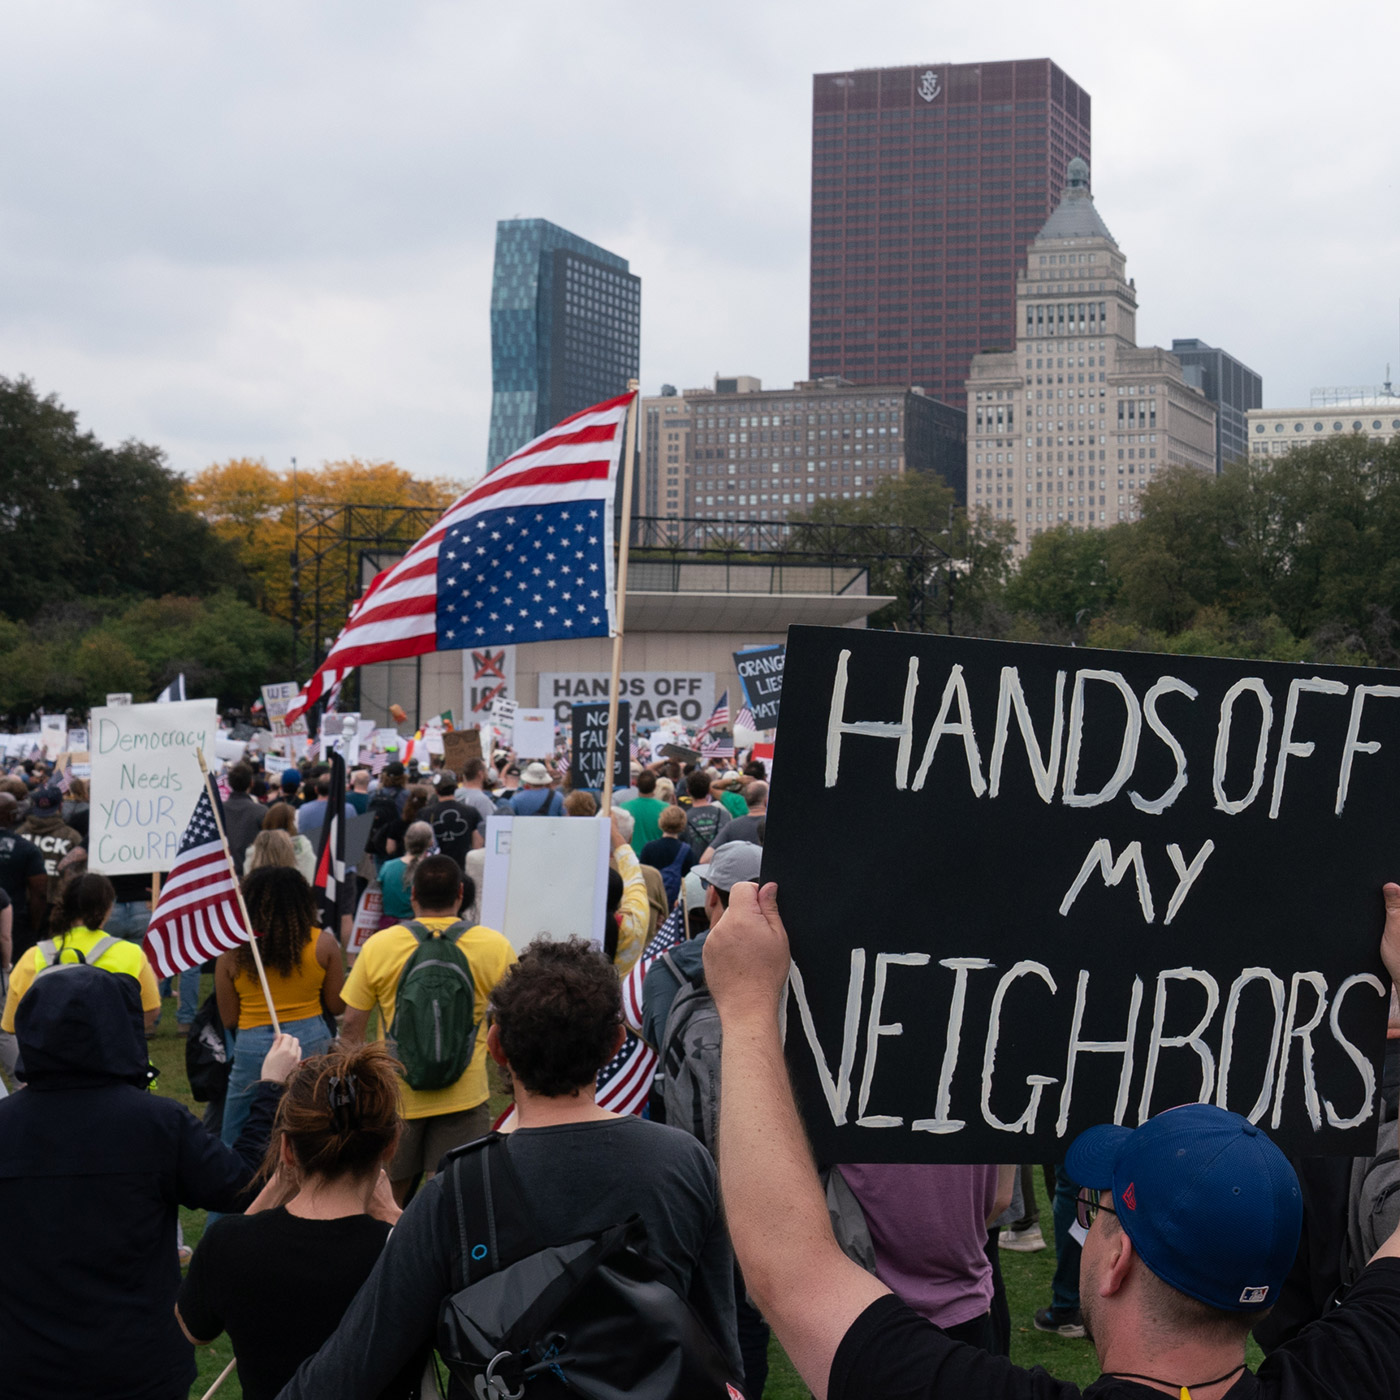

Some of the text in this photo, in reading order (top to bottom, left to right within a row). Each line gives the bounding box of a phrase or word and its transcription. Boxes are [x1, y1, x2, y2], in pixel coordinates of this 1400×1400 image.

[654, 678, 702, 696] OFF
[553, 699, 703, 723] CAGO
[751, 699, 780, 719] MAT
[99, 718, 206, 758] Democracy
[824, 649, 1198, 815] HANDS
[120, 763, 183, 791] Needs
[98, 831, 186, 864] CouRA
[1058, 838, 1215, 925] MY
[781, 947, 1386, 1138] NEIGHBORS
